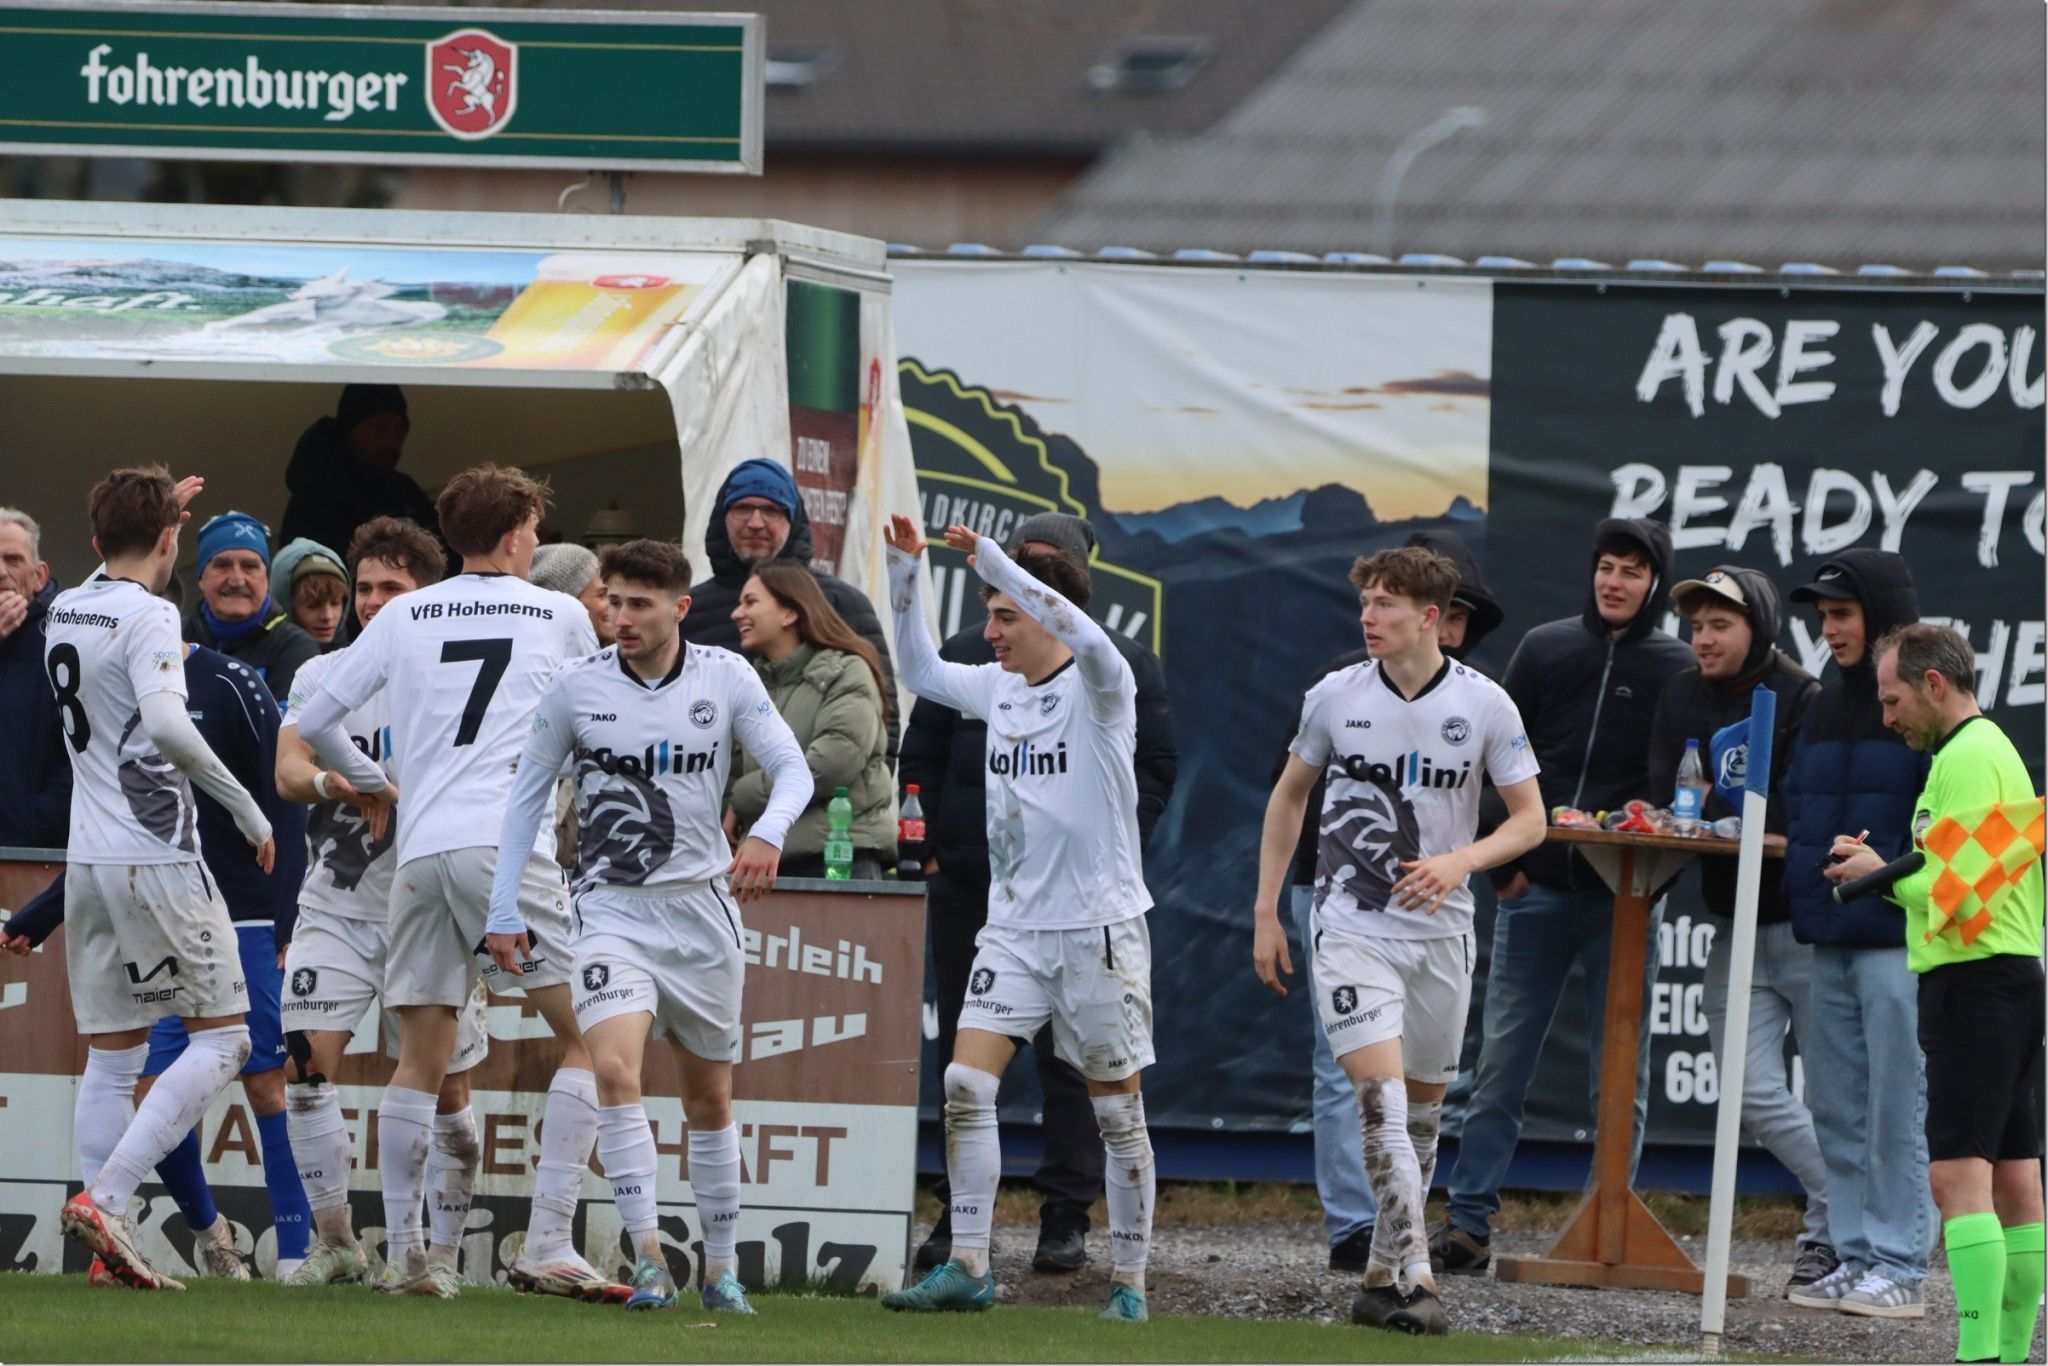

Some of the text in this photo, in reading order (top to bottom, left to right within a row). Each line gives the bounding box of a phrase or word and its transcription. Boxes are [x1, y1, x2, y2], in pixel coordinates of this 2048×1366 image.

[1637, 312, 1840, 419] ARE
[1610, 463, 1938, 567] READY
[53, 608, 119, 629] Hohenems
[410, 601, 554, 620] VfB Hohenems
[48, 642, 91, 754] 8
[440, 637, 513, 748] 7
[591, 713, 617, 723] JAKO
[1345, 719, 1371, 729] JAKO
[593, 739, 719, 779] Collini
[989, 738, 1067, 781] Collini
[1346, 750, 1470, 790] Collini
[1108, 1057, 1128, 1069] JAKO
[300, 1169, 323, 1180] AKO
[614, 1185, 642, 1197] JAKO
[437, 1202, 469, 1213] JAKO
[618, 1214, 880, 1299] Sulz
